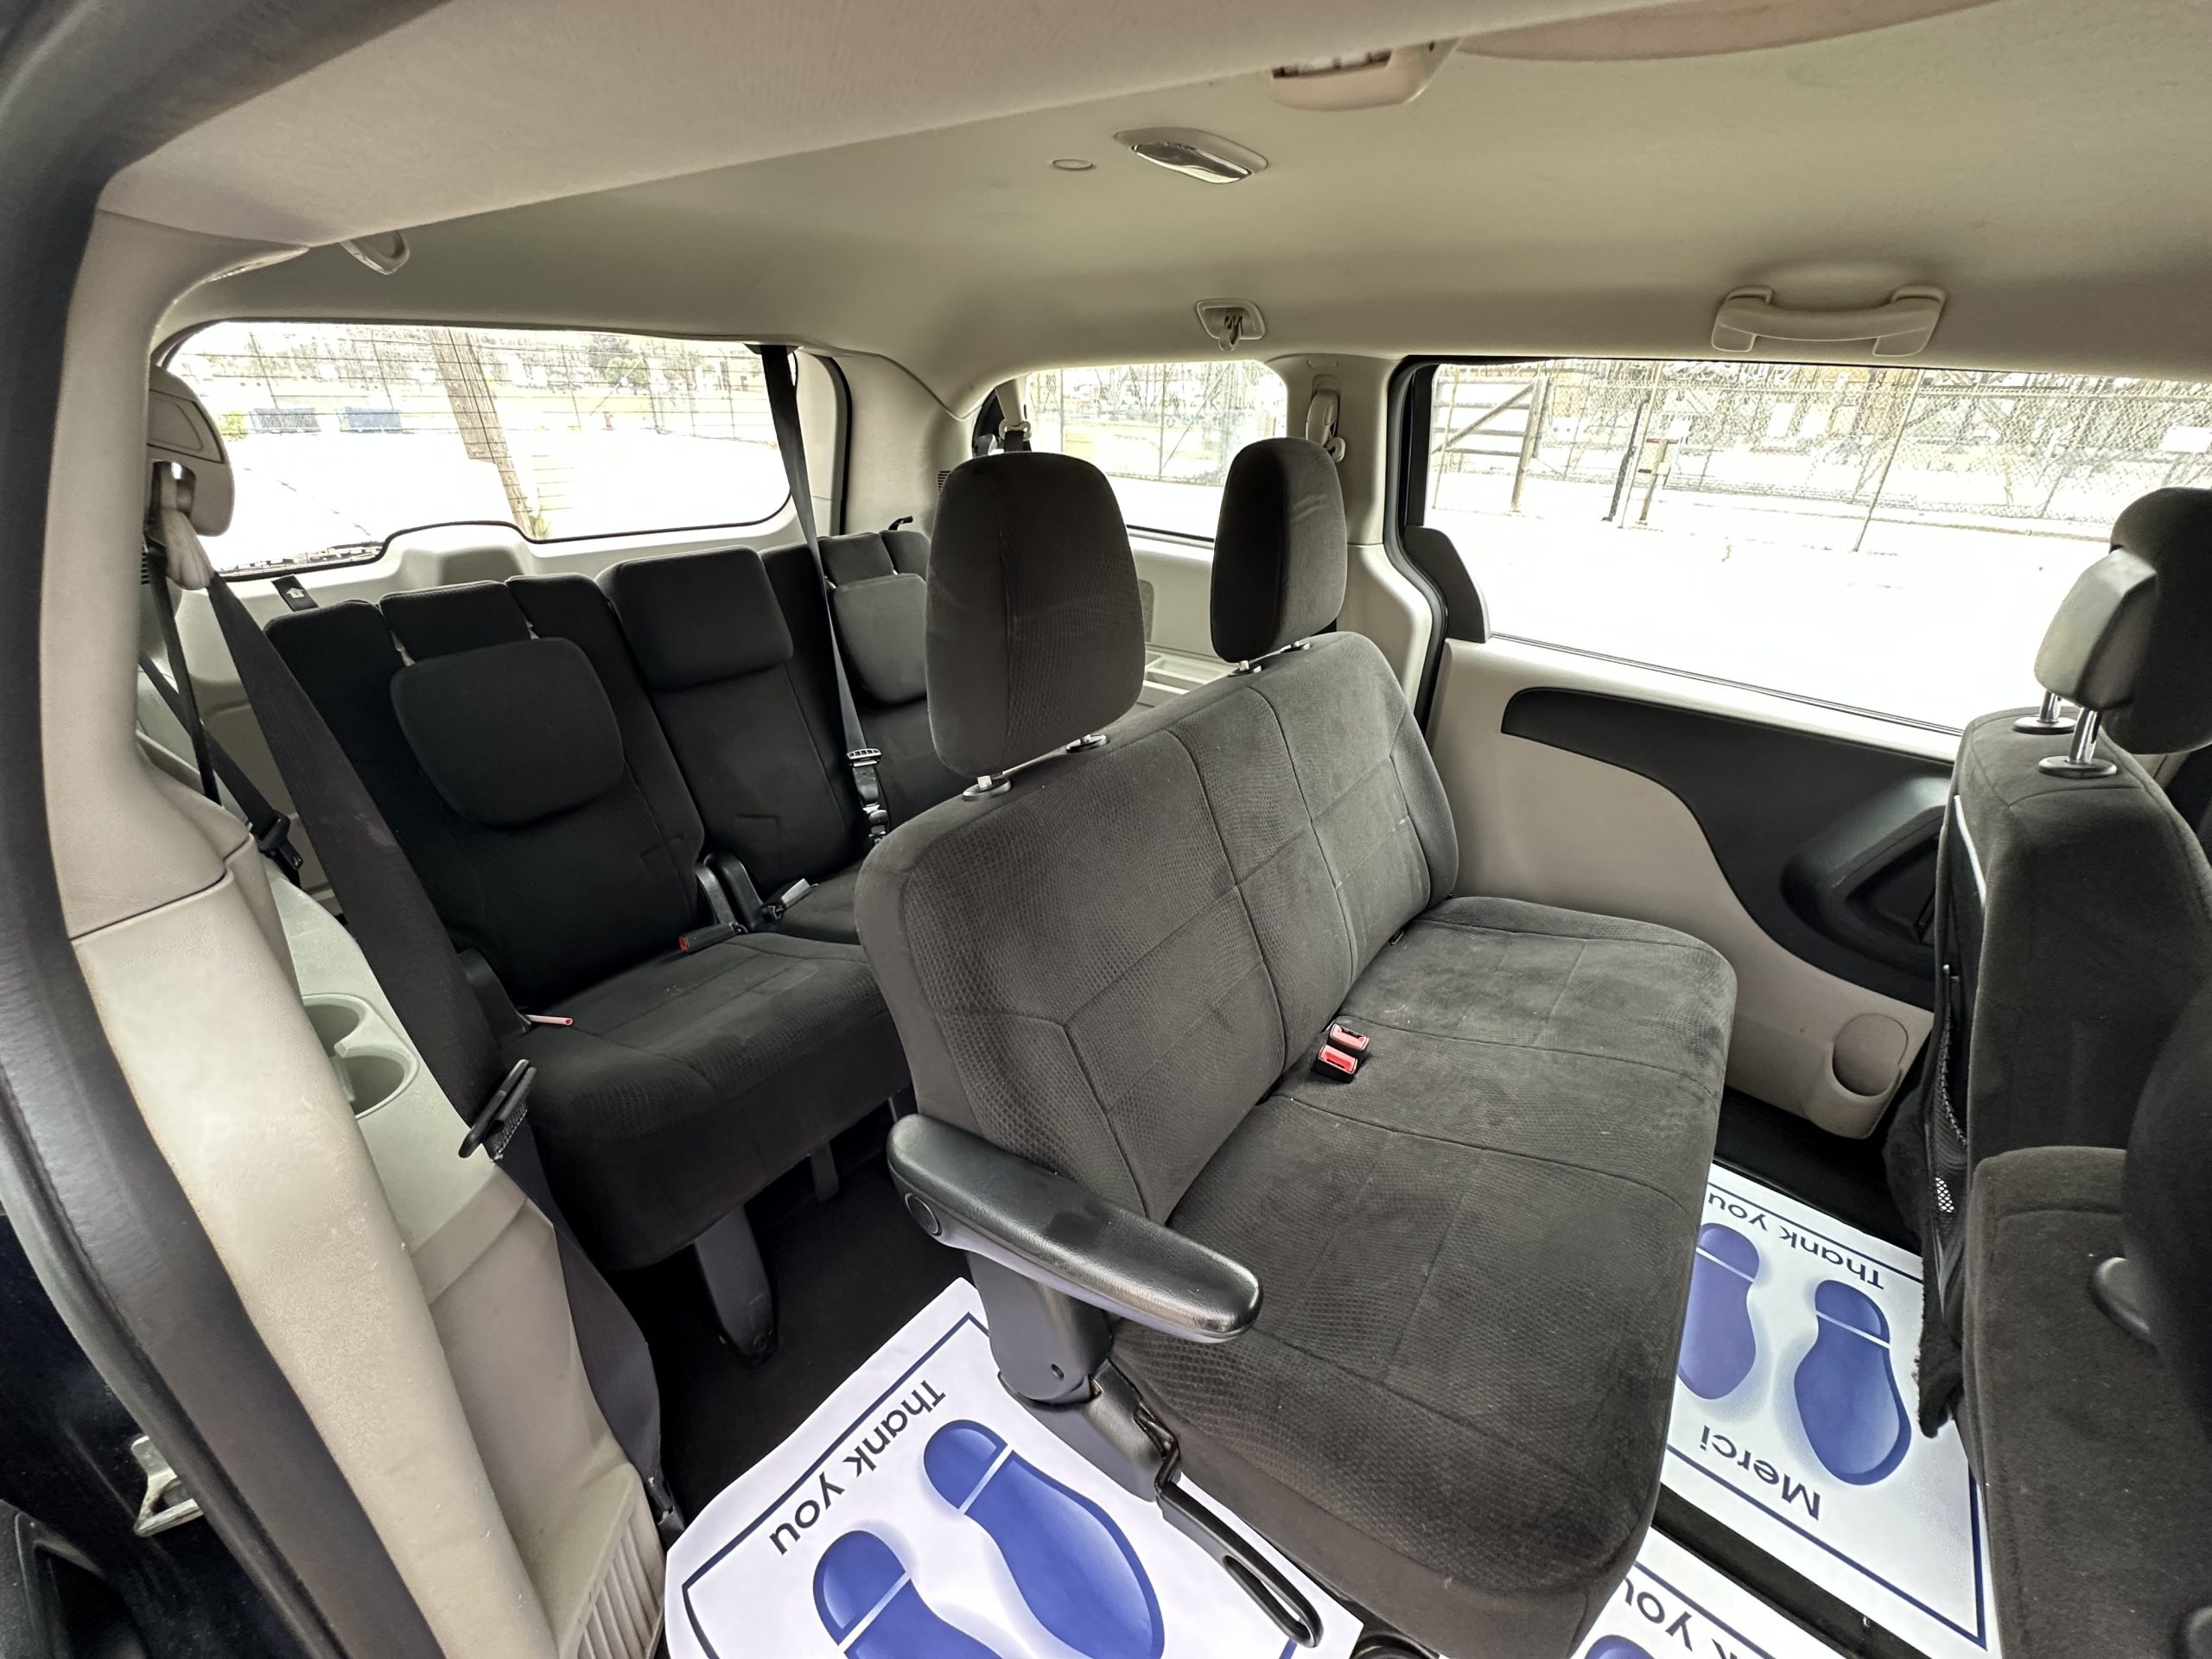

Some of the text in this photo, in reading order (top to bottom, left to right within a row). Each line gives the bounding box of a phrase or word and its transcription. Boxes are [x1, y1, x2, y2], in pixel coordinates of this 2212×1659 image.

[1707, 1192, 1885, 1290] Thank you
[768, 1380, 947, 1555] Thank you
[1699, 1425, 1821, 1522] Merci
